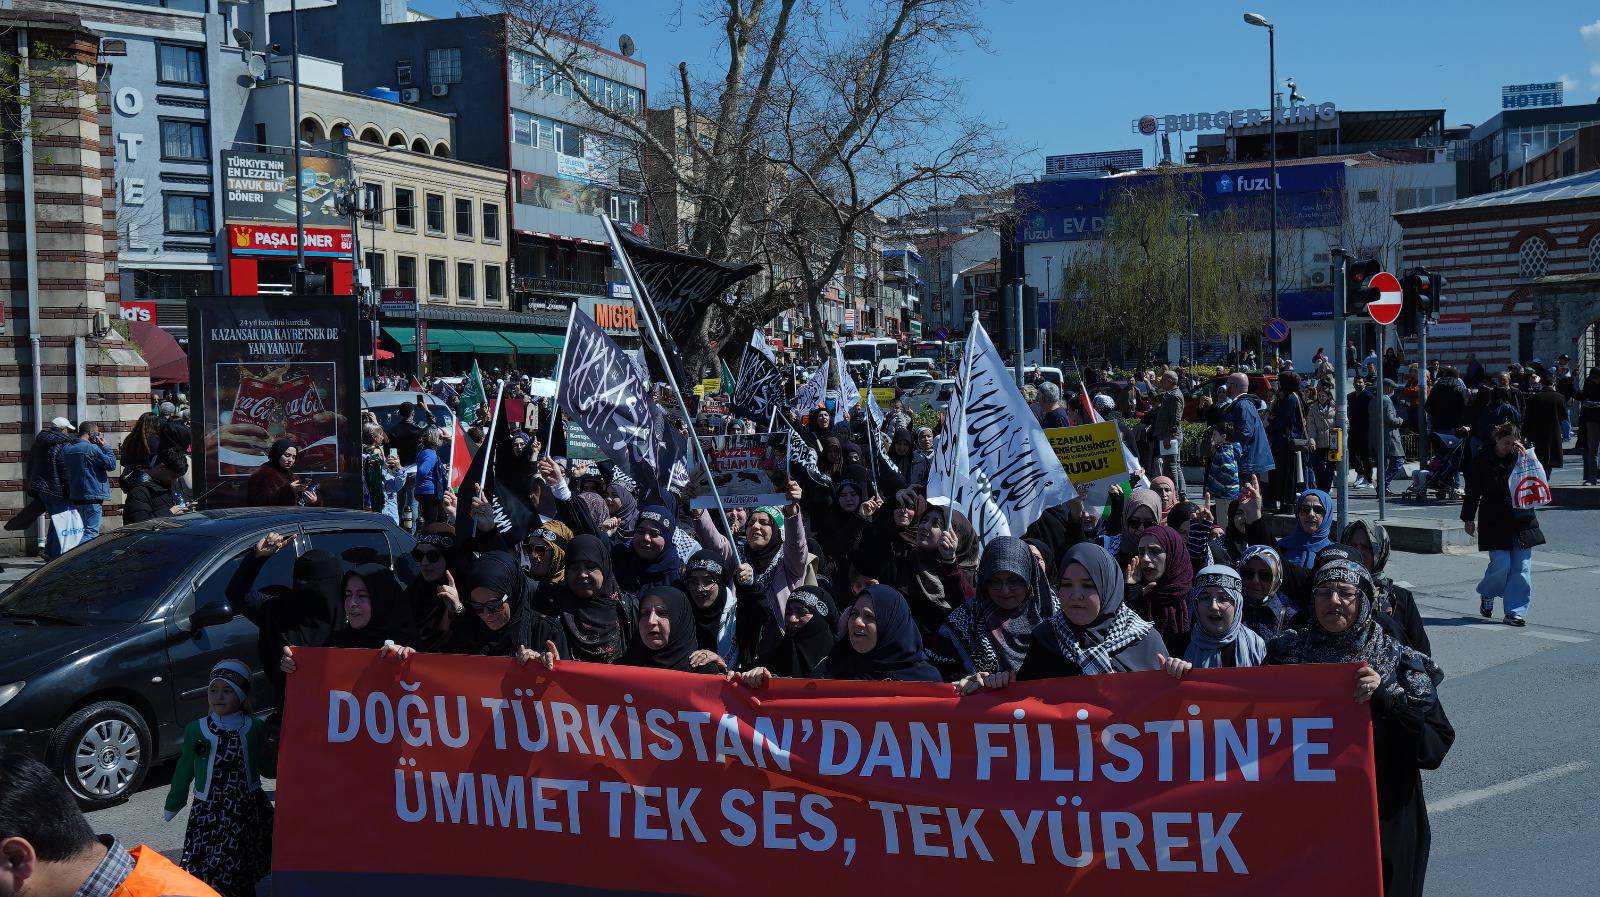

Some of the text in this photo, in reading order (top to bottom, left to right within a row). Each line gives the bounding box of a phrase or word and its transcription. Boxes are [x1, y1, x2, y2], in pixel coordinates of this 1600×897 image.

[1502, 93, 1563, 108] HOTEL
[1165, 109, 1262, 132] BURGER
[1274, 102, 1336, 127] KING
[115, 87, 147, 250] OTEL
[228, 167, 284, 180] EN LEZZETLİ
[228, 179, 285, 192] TAVUK BUT
[228, 190, 264, 203] DÖNERİ
[1063, 217, 1086, 234] EV
[255, 232, 290, 249] PAŞA
[1023, 226, 1056, 241] fuzul
[239, 319, 249, 327] 24
[258, 319, 285, 328] hayalini
[285, 319, 311, 327] kurduk
[211, 327, 340, 341] KAZANSAK DA KAYBETSEK DE
[248, 343, 304, 355] YAN YANAYIZ
[1056, 434, 1092, 446] ZAMAN
[327, 680, 1336, 783] DOĞU TÜRKİSTAN'DAN FİLİSTİN'E
[394, 757, 1250, 875] ÜMMET TEK SES, TEK YÜREK
